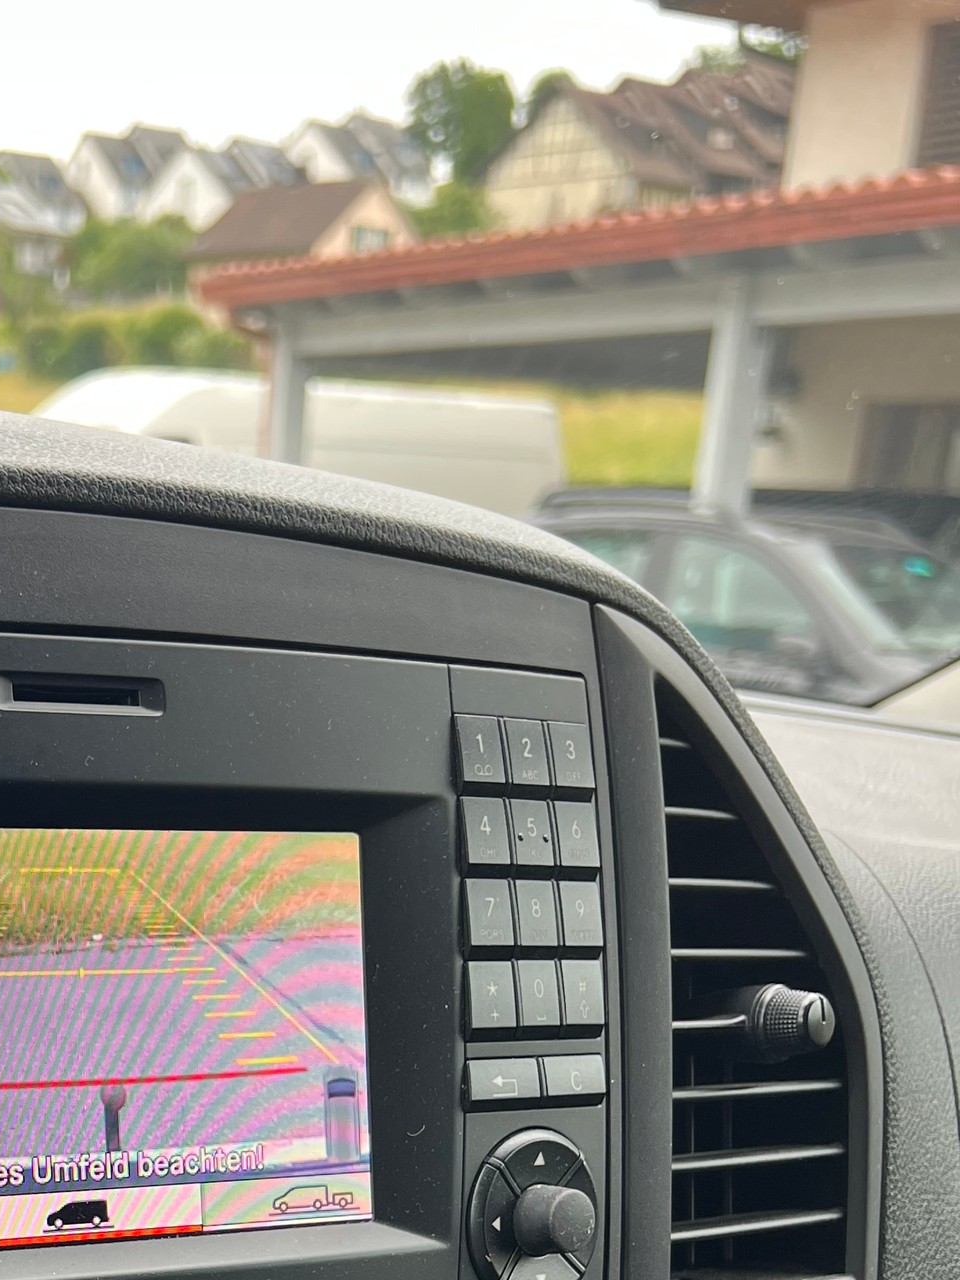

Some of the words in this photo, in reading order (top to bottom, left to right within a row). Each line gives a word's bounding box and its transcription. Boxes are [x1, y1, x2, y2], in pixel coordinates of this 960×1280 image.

[475, 733, 484, 754] 1
[521, 737, 533, 758] 2
[565, 740, 576, 760] 3
[521, 769, 540, 780] ABC
[480, 815, 492, 836] 4
[526, 817, 538, 837] 5
[571, 819, 582, 839] 6
[484, 897, 495, 917] 7
[530, 898, 541, 918] 8
[575, 899, 585, 919] 9
[533, 978, 544, 998] 0
[571, 1071, 582, 1091] C
[32, 1150, 130, 1184] Umfeld
[137, 1143, 265, 1178] beachten!
